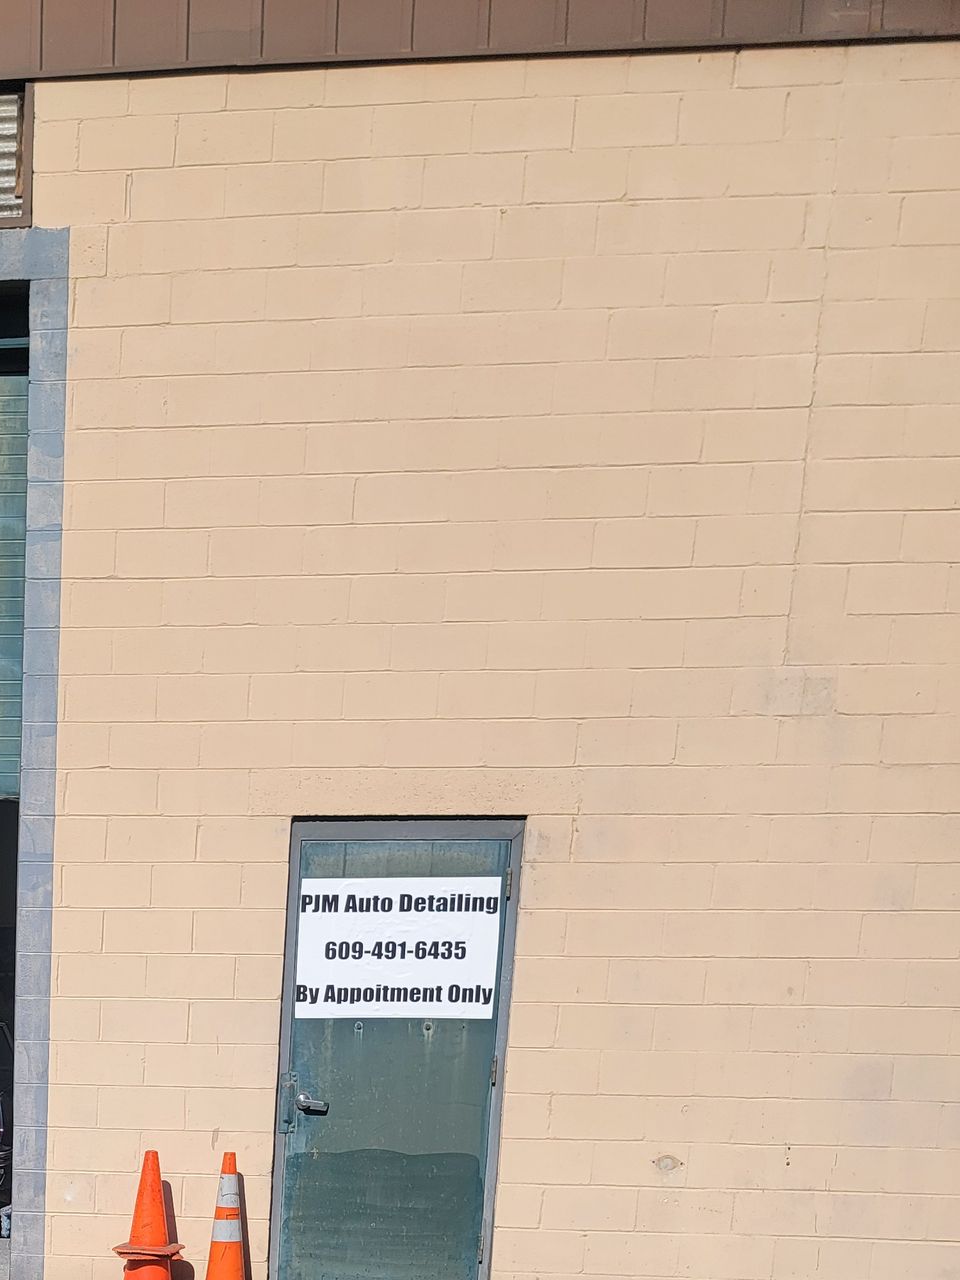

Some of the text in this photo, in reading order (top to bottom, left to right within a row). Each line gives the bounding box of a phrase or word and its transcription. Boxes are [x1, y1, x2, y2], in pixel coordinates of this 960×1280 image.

[301, 893, 499, 915] PJM Auto Detailing
[324, 940, 467, 960] 609-491-6435
[295, 984, 493, 1005] By Appoitment Only
